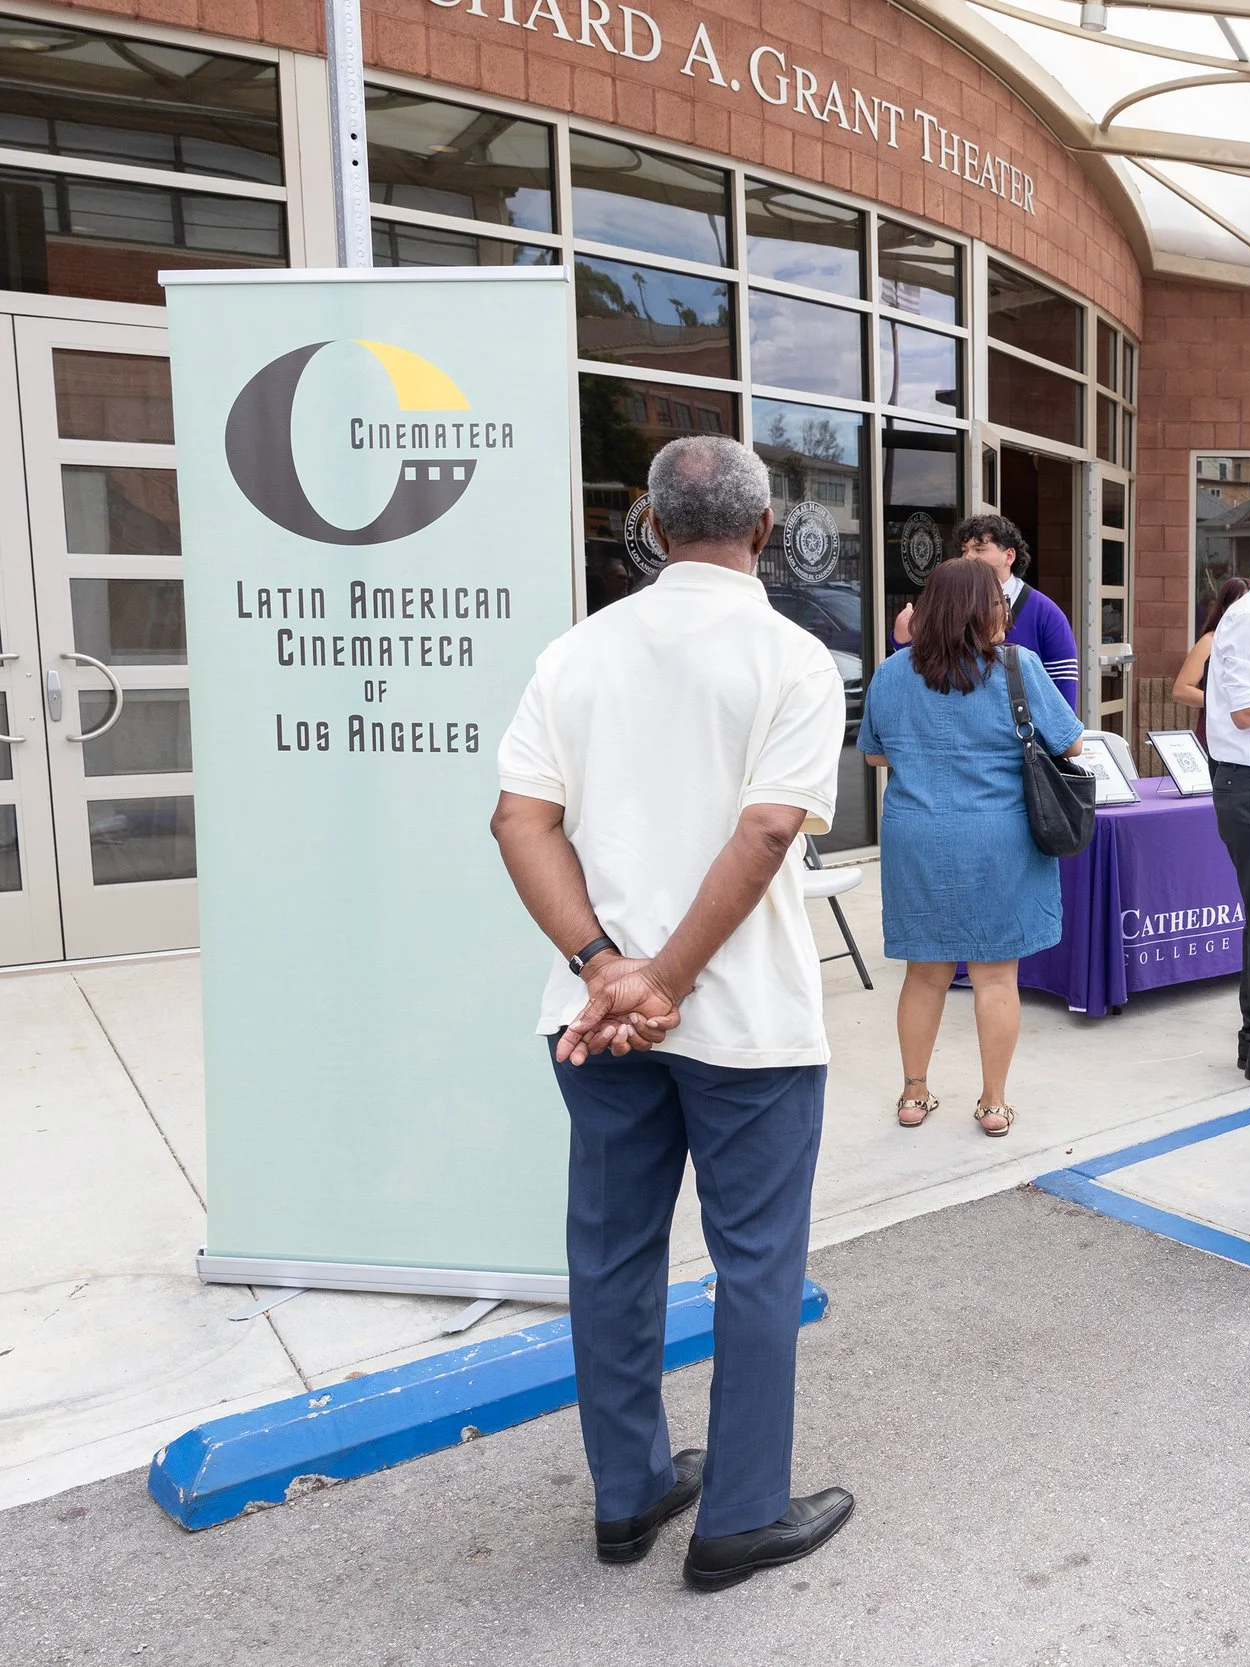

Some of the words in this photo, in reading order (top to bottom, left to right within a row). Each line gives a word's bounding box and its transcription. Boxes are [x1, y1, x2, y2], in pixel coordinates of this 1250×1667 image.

[430, 0, 662, 62] ARD
[680, 22, 740, 92] A.
[749, 45, 905, 149] GRANT
[914, 108, 1036, 216] THEATER
[350, 417, 514, 449] CINEMATECA
[626, 496, 652, 540] CATHEDRA
[785, 504, 808, 547] CATHEDRAL
[631, 549, 641, 562] LOS
[236, 580, 325, 619] LATIN
[350, 580, 511, 619] AMERICAN
[277, 628, 473, 667] CINEMATECA
[276, 713, 330, 752] LOS
[348, 714, 479, 753] ANGELES
[1120, 902, 1245, 940] CATHEDRA
